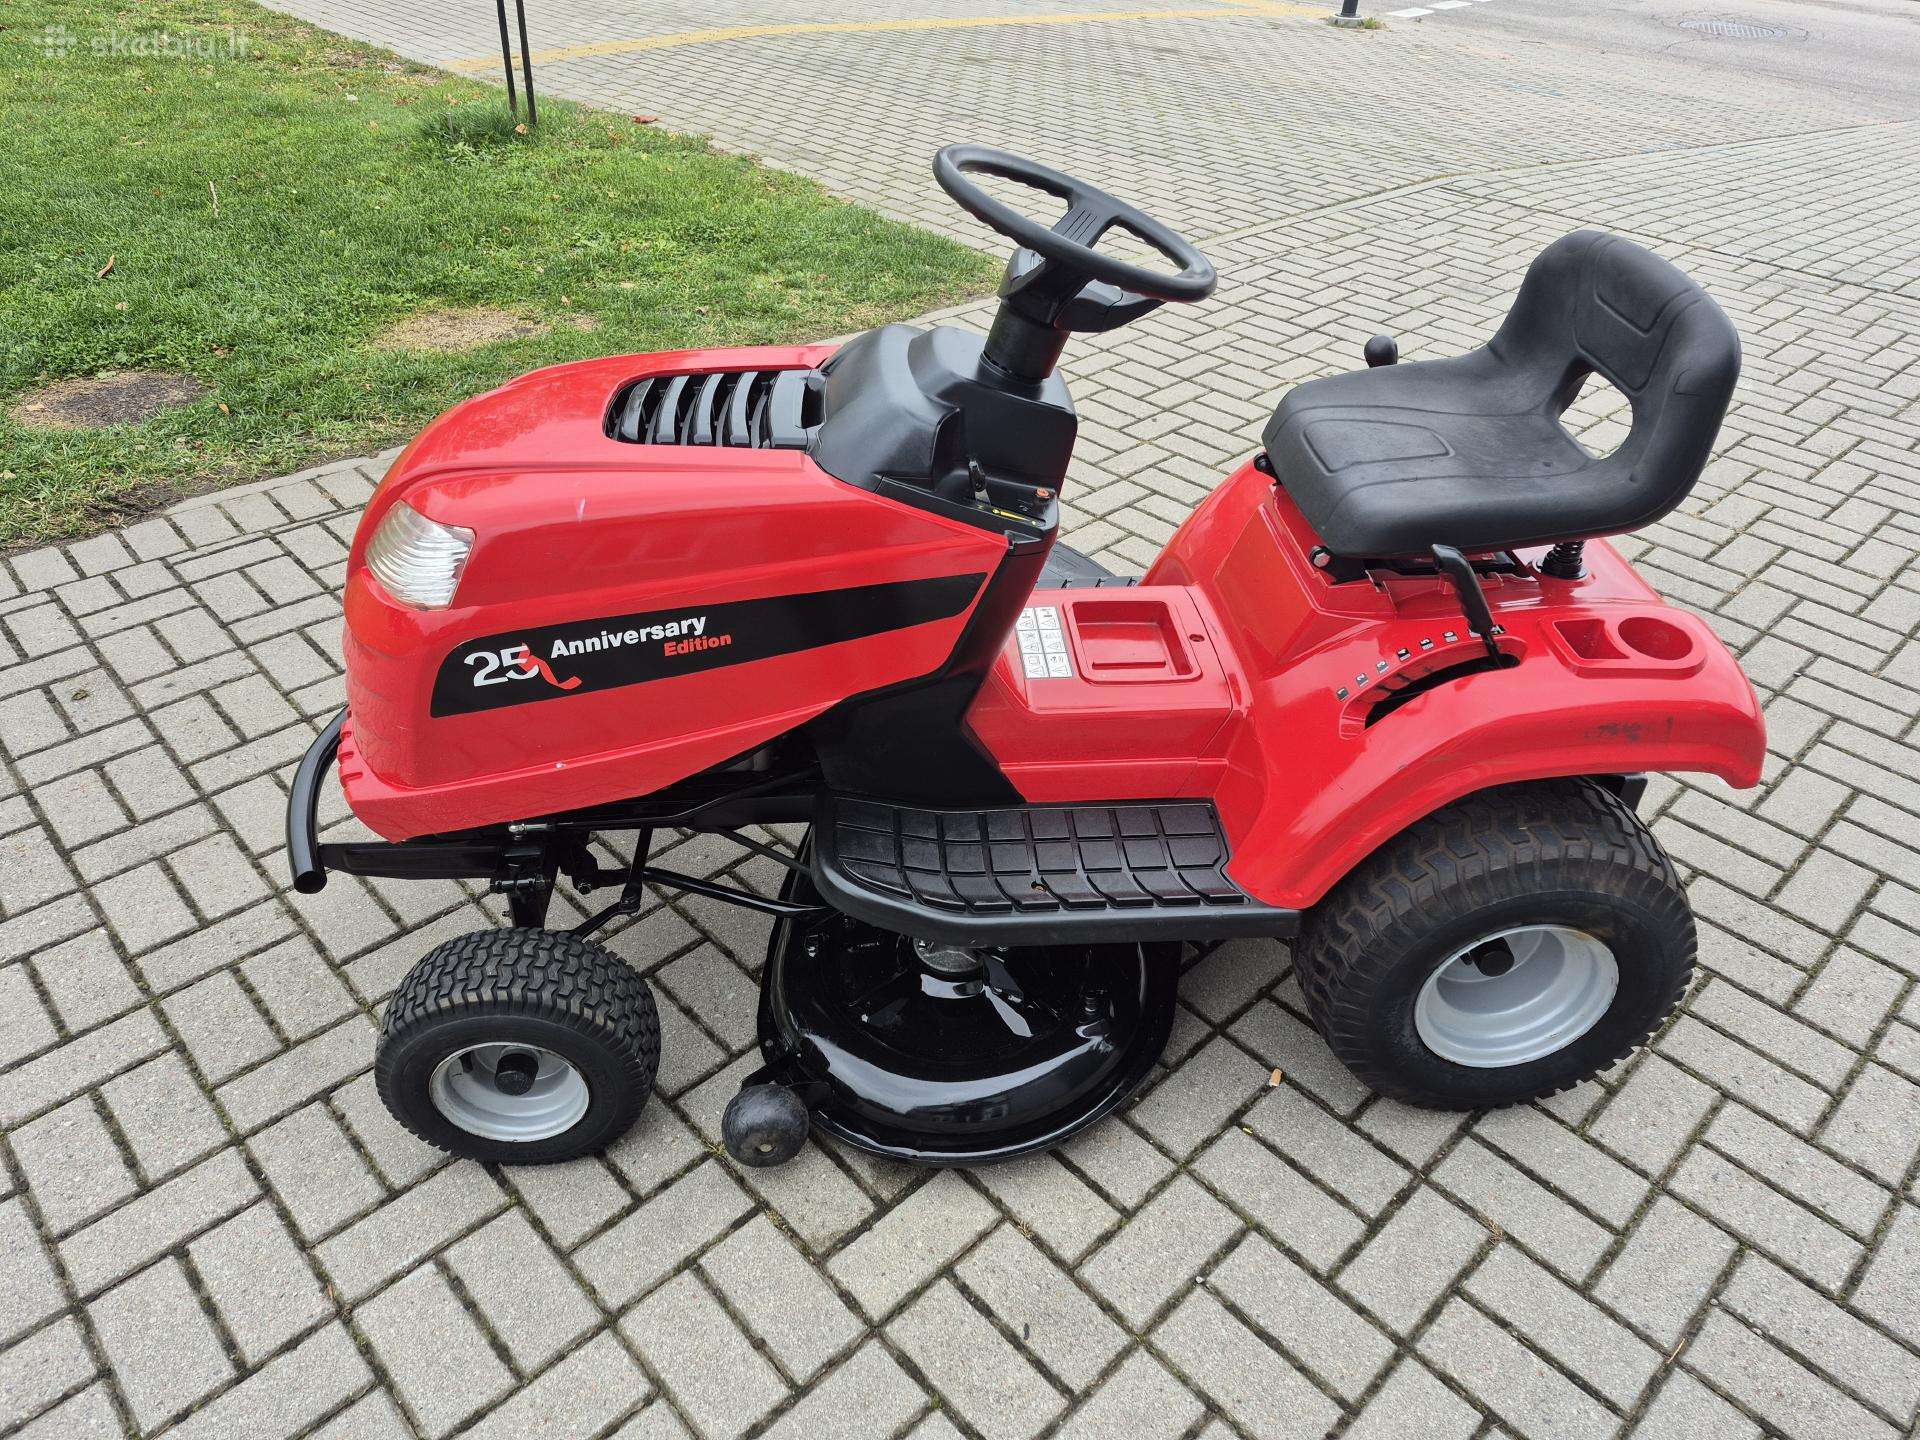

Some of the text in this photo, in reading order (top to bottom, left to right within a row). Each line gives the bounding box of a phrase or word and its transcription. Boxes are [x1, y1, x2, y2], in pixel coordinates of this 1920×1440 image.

[463, 616, 707, 687] 25 Anniversary
[664, 634, 732, 657] Edition
